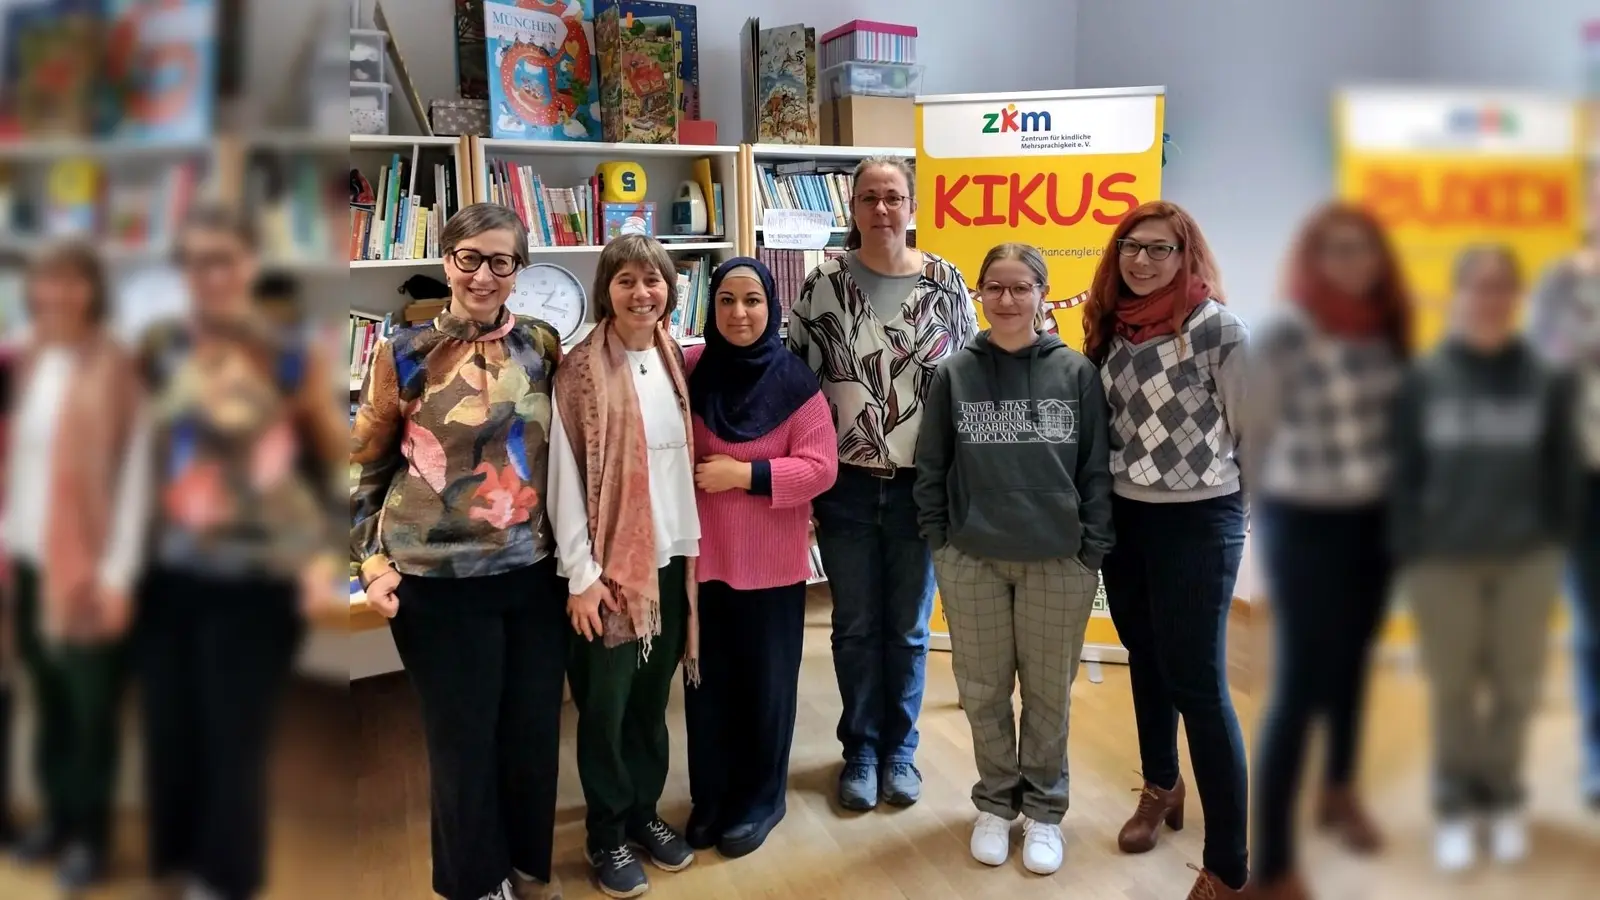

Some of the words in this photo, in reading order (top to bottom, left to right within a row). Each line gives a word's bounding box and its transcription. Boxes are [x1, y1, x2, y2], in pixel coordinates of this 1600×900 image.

[982, 104, 1051, 133] zkm
[621, 171, 637, 192] 5
[935, 172, 1139, 229] KIKUS
[962, 411, 1026, 422] STUDIORUM
[957, 421, 1033, 432] ZAGRABIENSIS
[970, 432, 1019, 442] MDCLXIX
